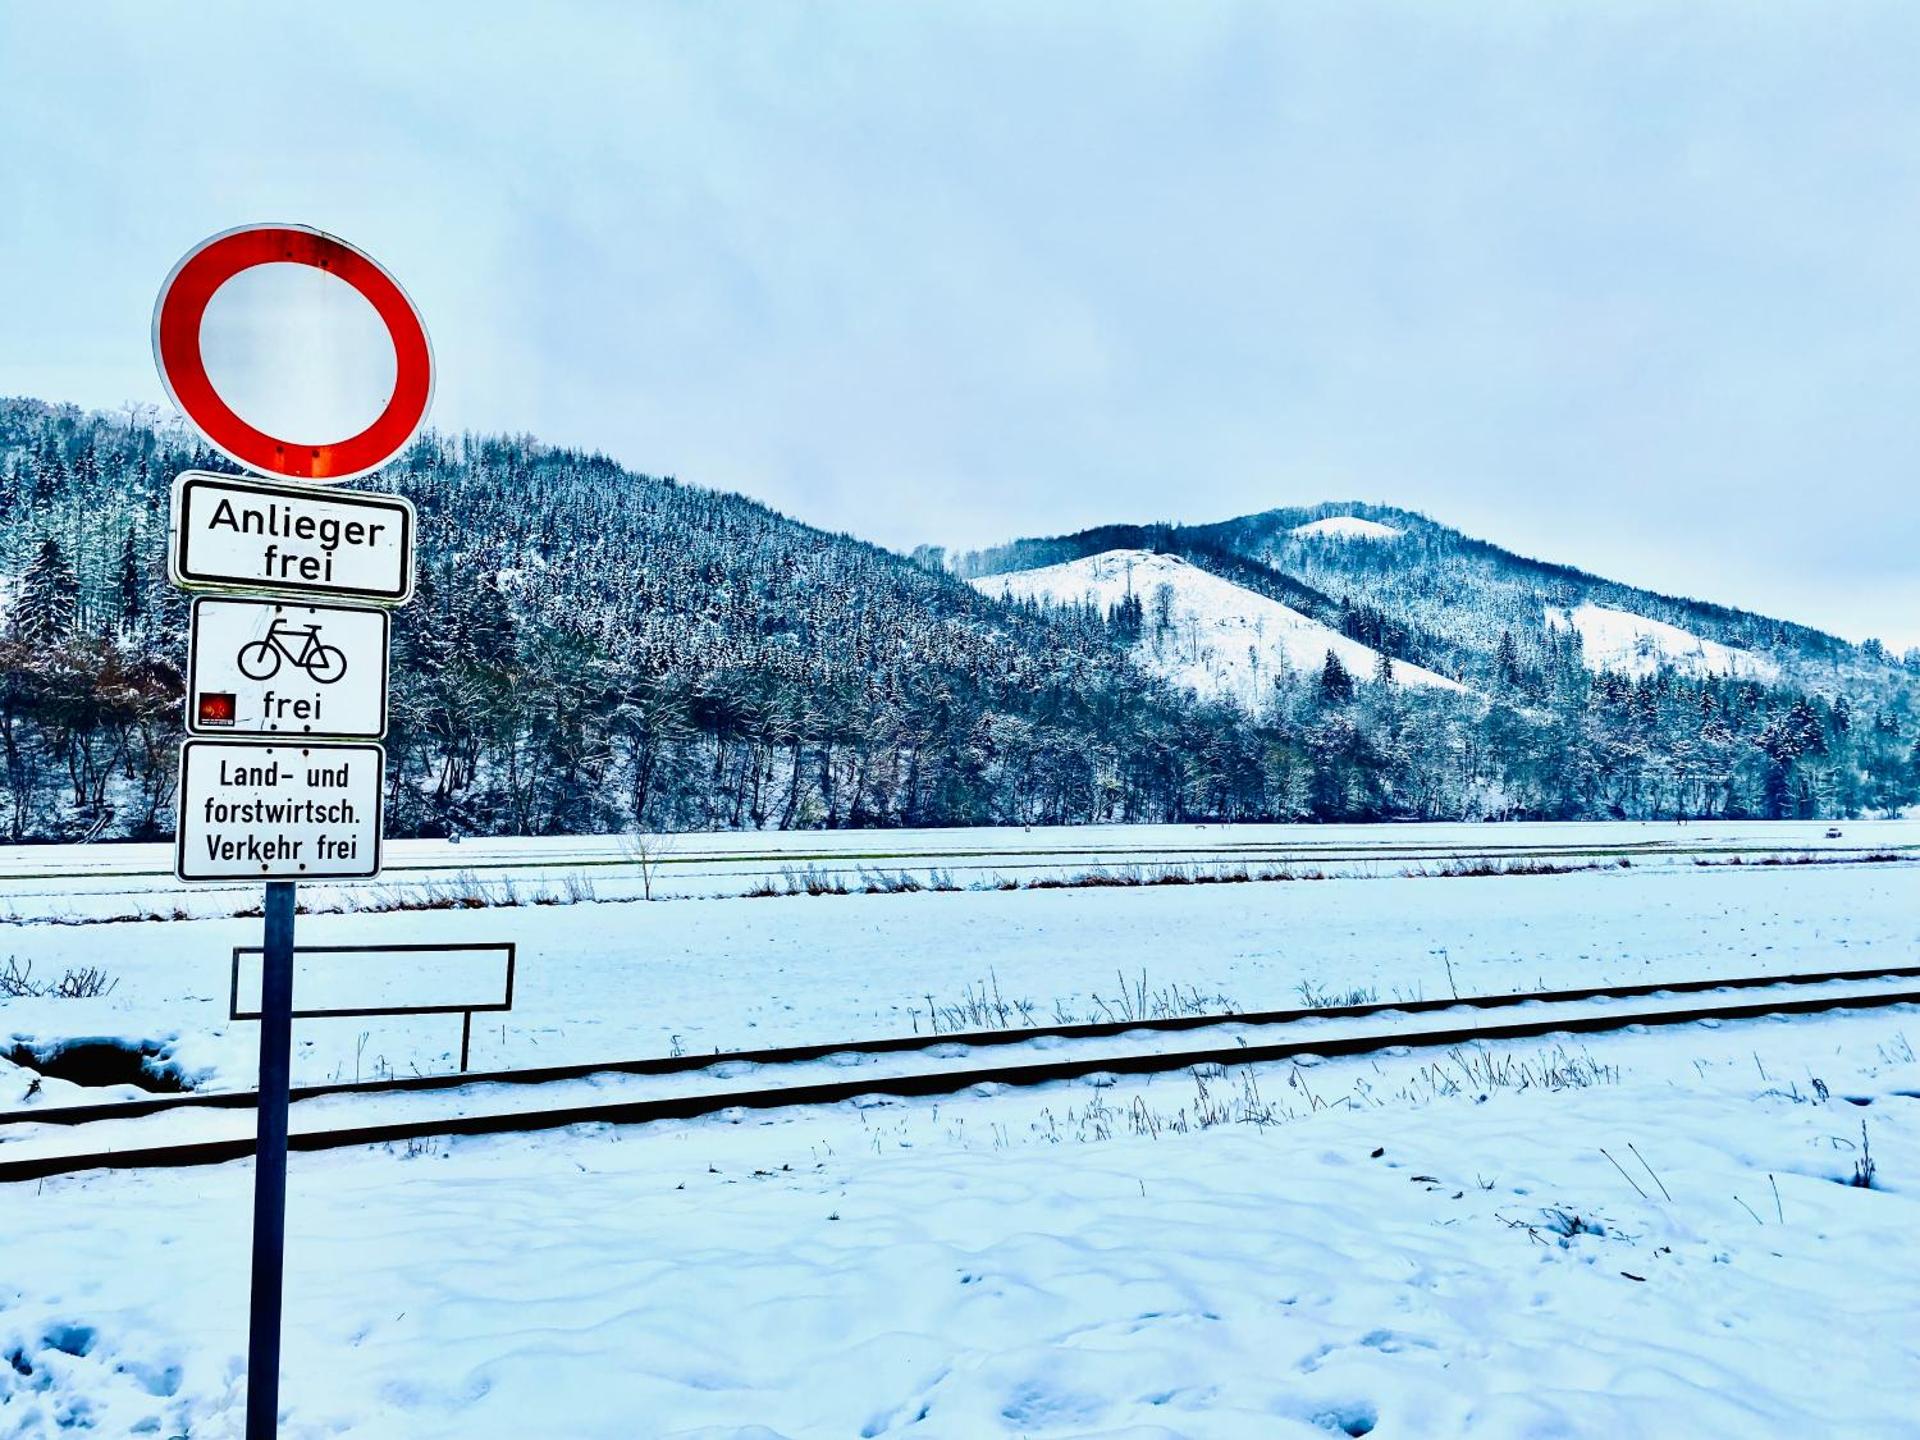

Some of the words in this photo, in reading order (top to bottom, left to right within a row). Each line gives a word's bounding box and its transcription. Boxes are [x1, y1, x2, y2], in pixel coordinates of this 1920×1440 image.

[208, 498, 385, 550] Anlieger
[265, 544, 333, 582] frei
[263, 691, 321, 720] frei
[220, 760, 294, 787] Land-
[307, 763, 349, 788] und
[204, 797, 361, 824] forstwirtsch.
[206, 834, 303, 861] Verkehr
[317, 834, 357, 859] frei
